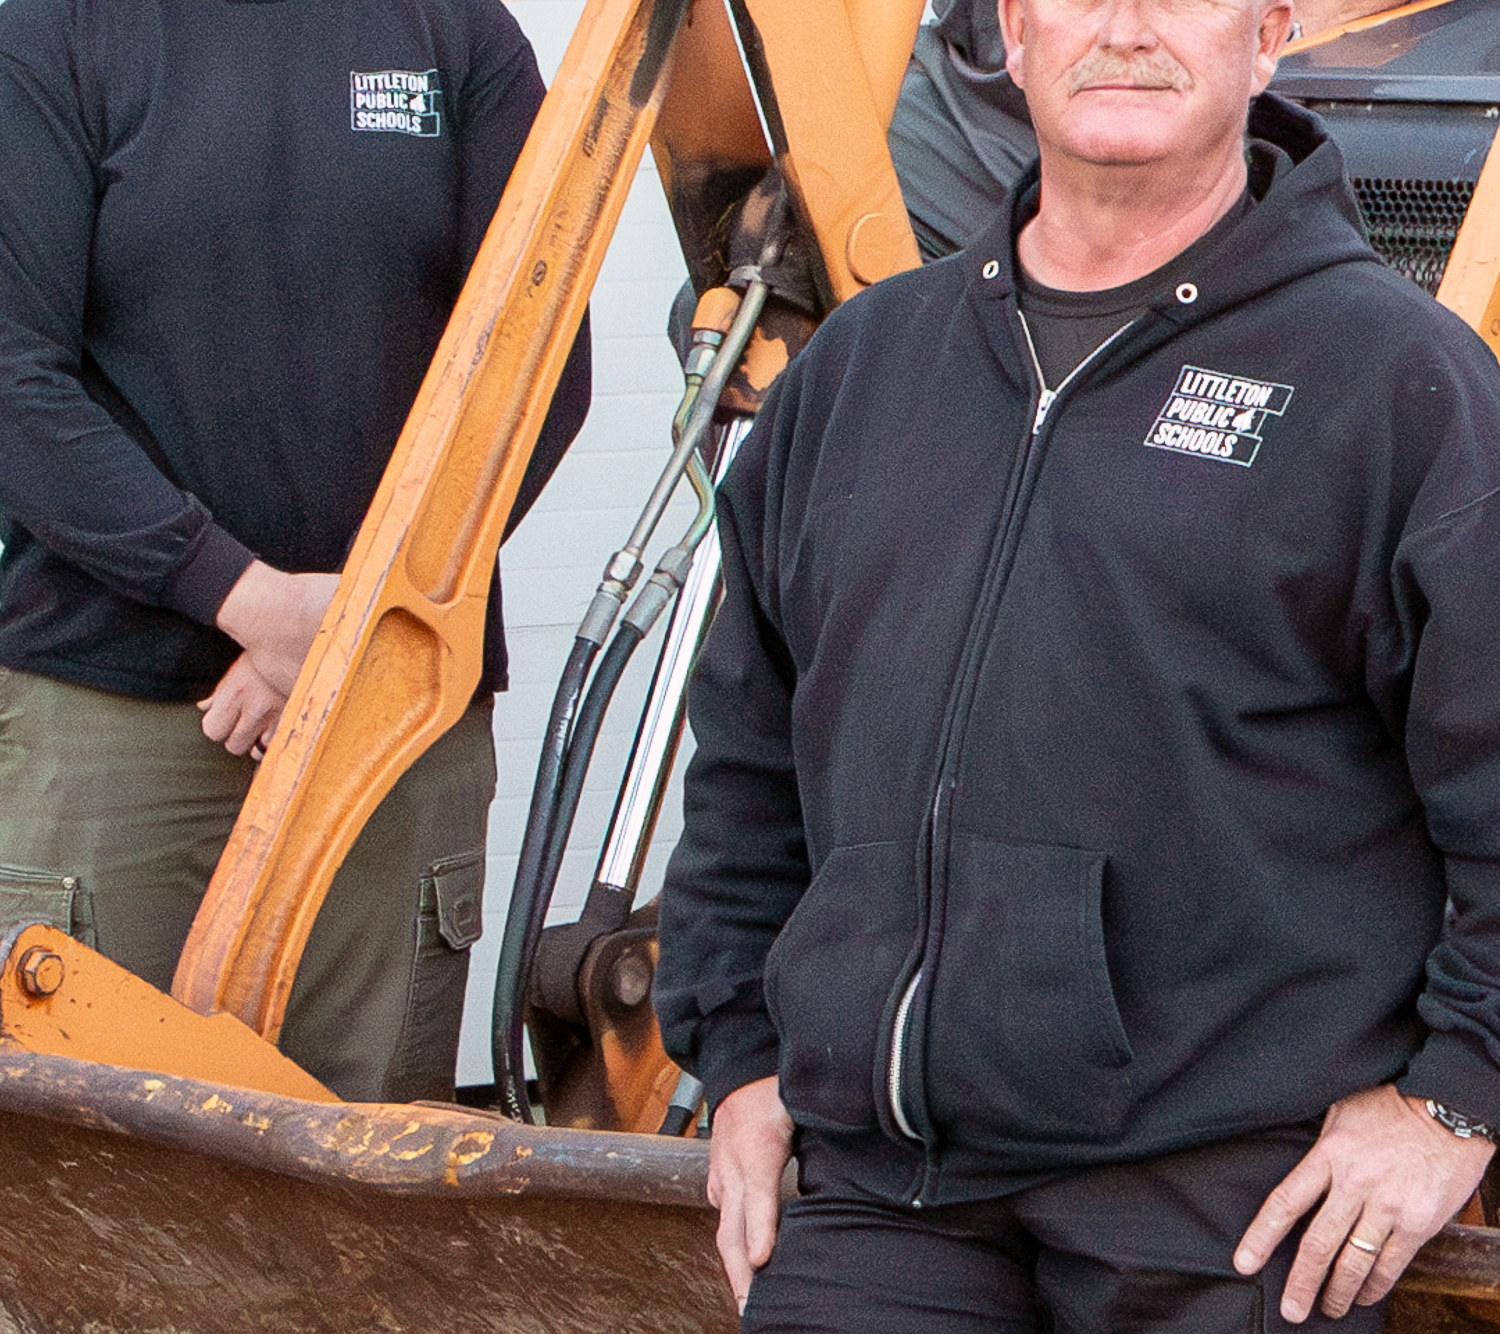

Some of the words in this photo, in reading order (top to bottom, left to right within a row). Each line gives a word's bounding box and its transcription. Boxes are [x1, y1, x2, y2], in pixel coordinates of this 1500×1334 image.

[354, 73, 428, 92] LITTLETON
[355, 92, 408, 109] PUBLIC
[356, 111, 421, 133] SCHOOLS
[1180, 371, 1273, 407] LITTLETON
[1166, 397, 1236, 428] PUBLIC
[1153, 422, 1238, 457] SCHOOLS
